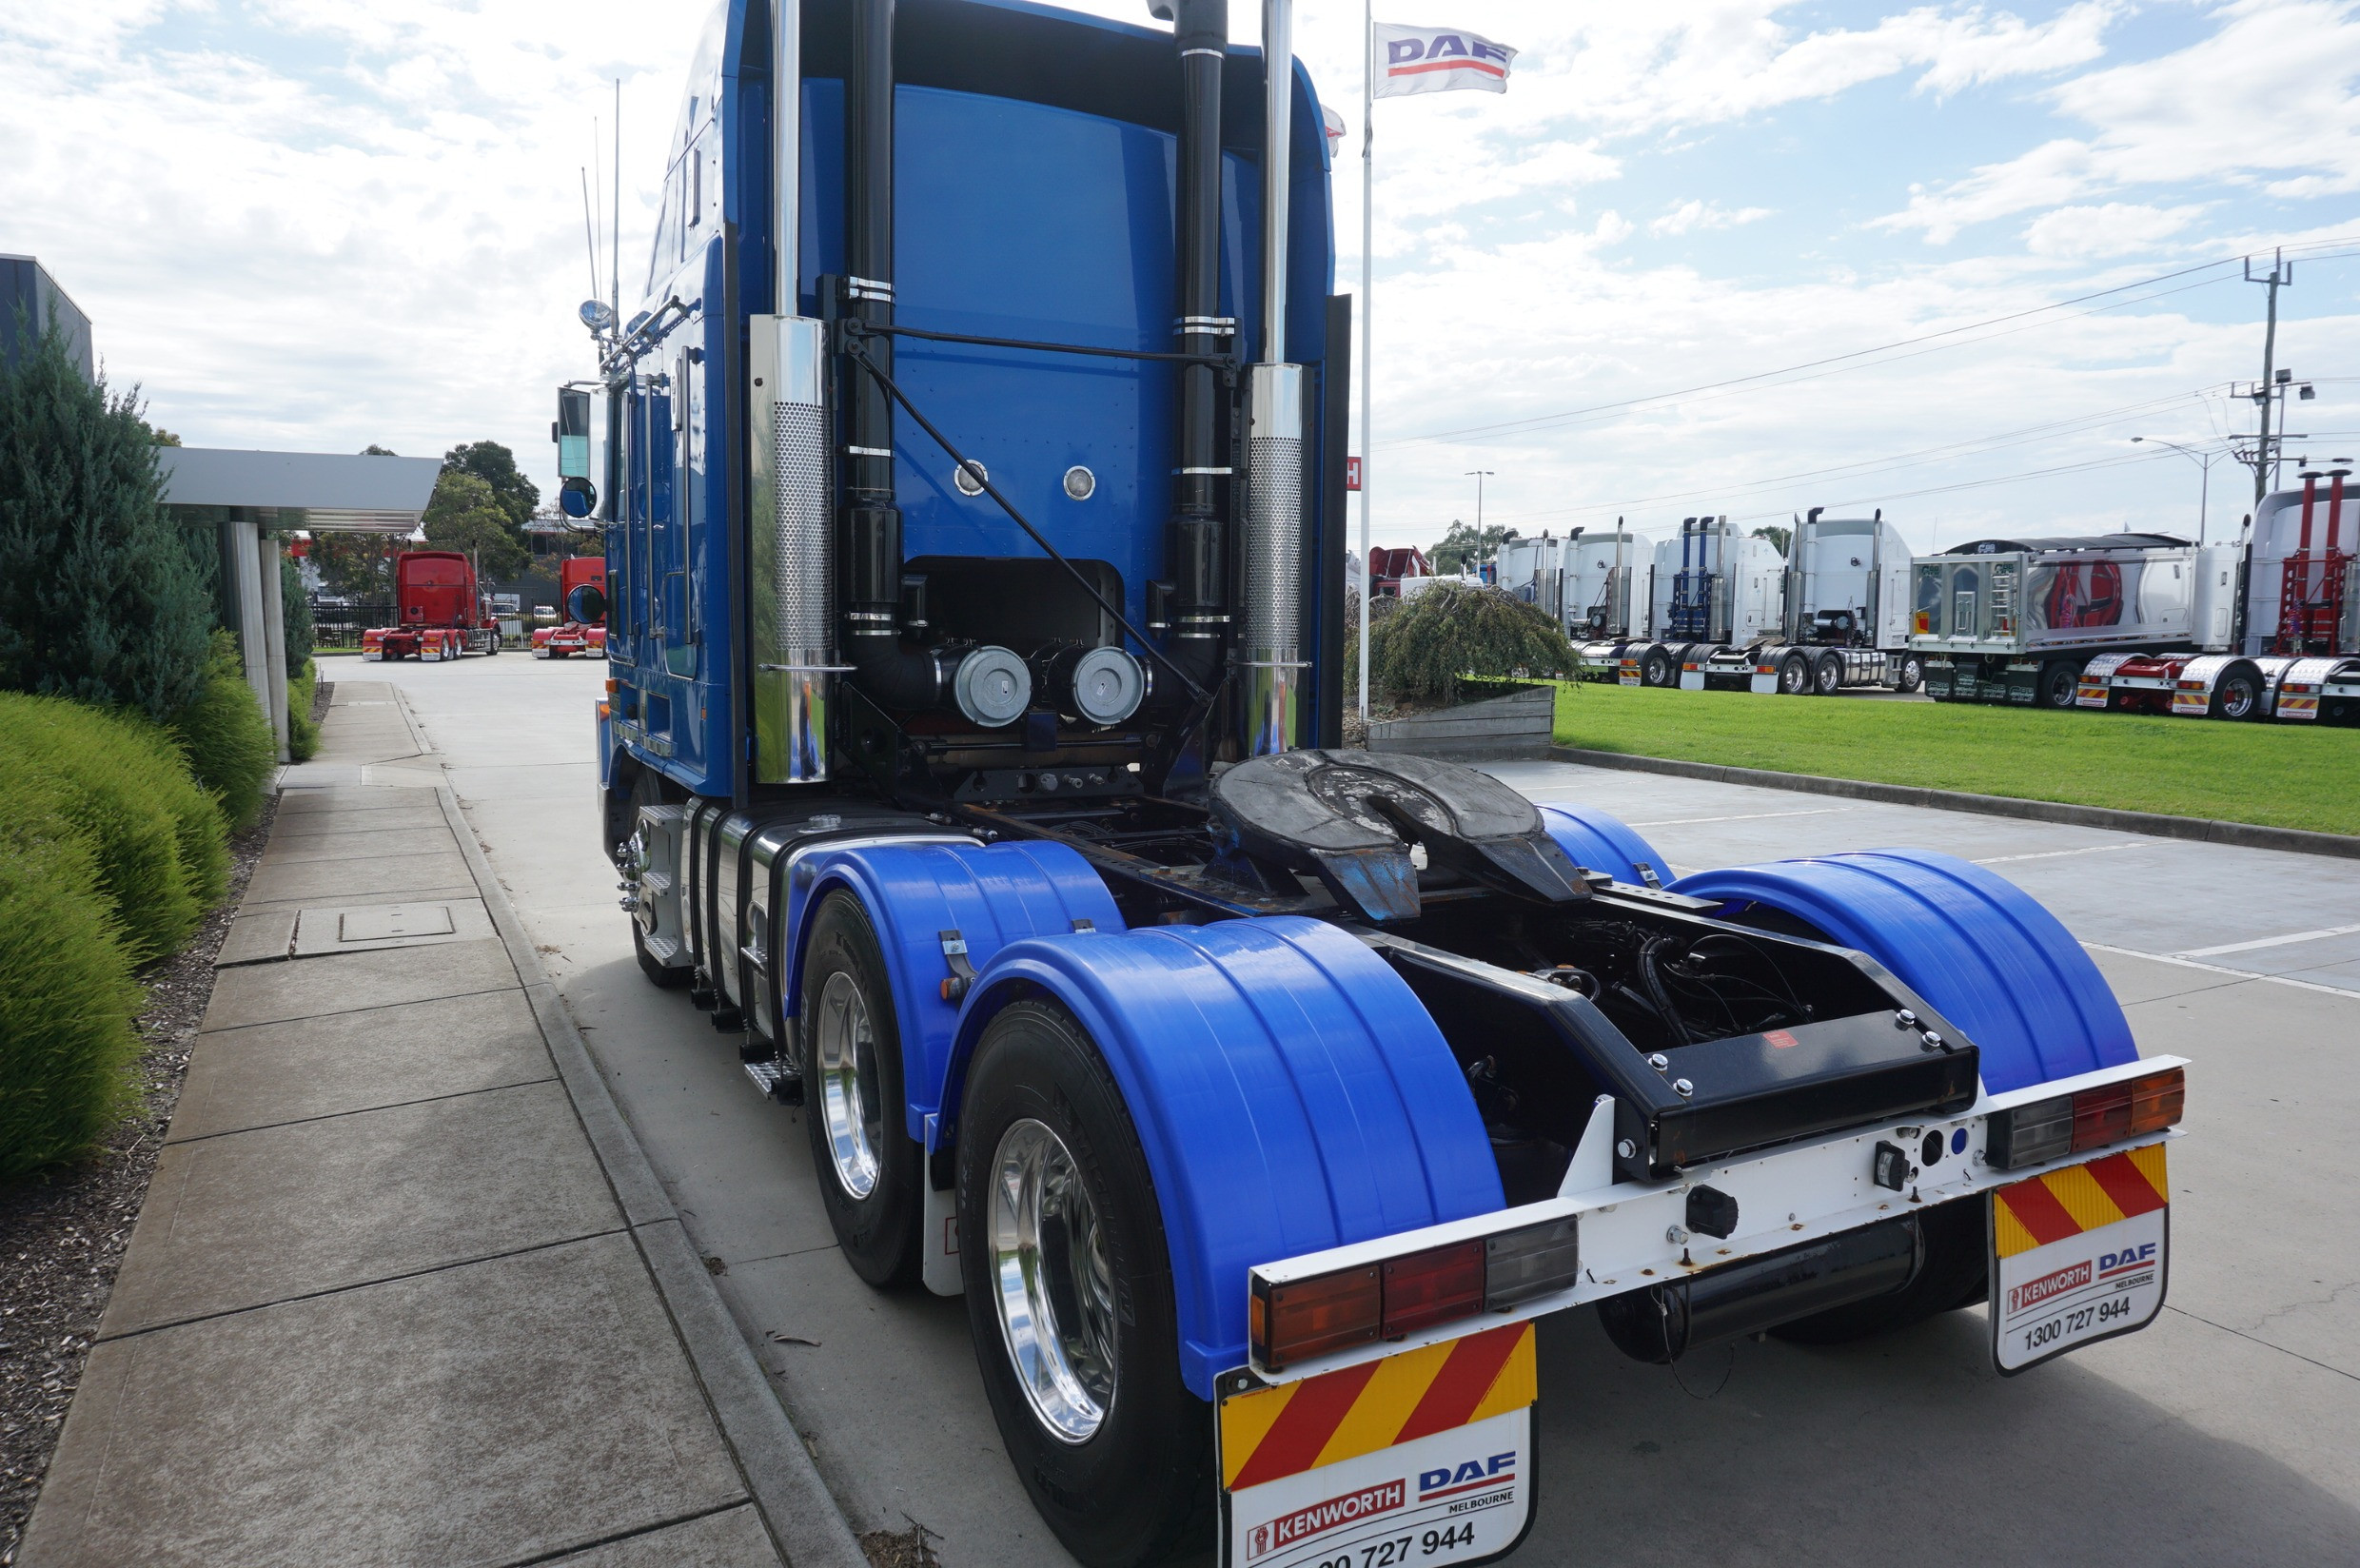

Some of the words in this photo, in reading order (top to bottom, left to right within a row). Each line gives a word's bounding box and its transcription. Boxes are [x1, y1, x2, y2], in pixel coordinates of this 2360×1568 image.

[1387, 34, 1506, 65] DAF
[2099, 1243, 2155, 1271] DAF
[2024, 1265, 2090, 1303] KENWORTH
[2115, 1273, 2154, 1289] MELBOURNE
[2025, 1319, 2062, 1350] 1300
[2066, 1306, 2095, 1334] 727
[2099, 1297, 2131, 1323] 944
[1419, 1451, 1516, 1492] DAF
[1279, 1484, 1401, 1542] KENWORTH
[1449, 1491, 1514, 1514] MELBOURNE
[1361, 1536, 1413, 1568] 727
[1422, 1520, 1475, 1555] 944
